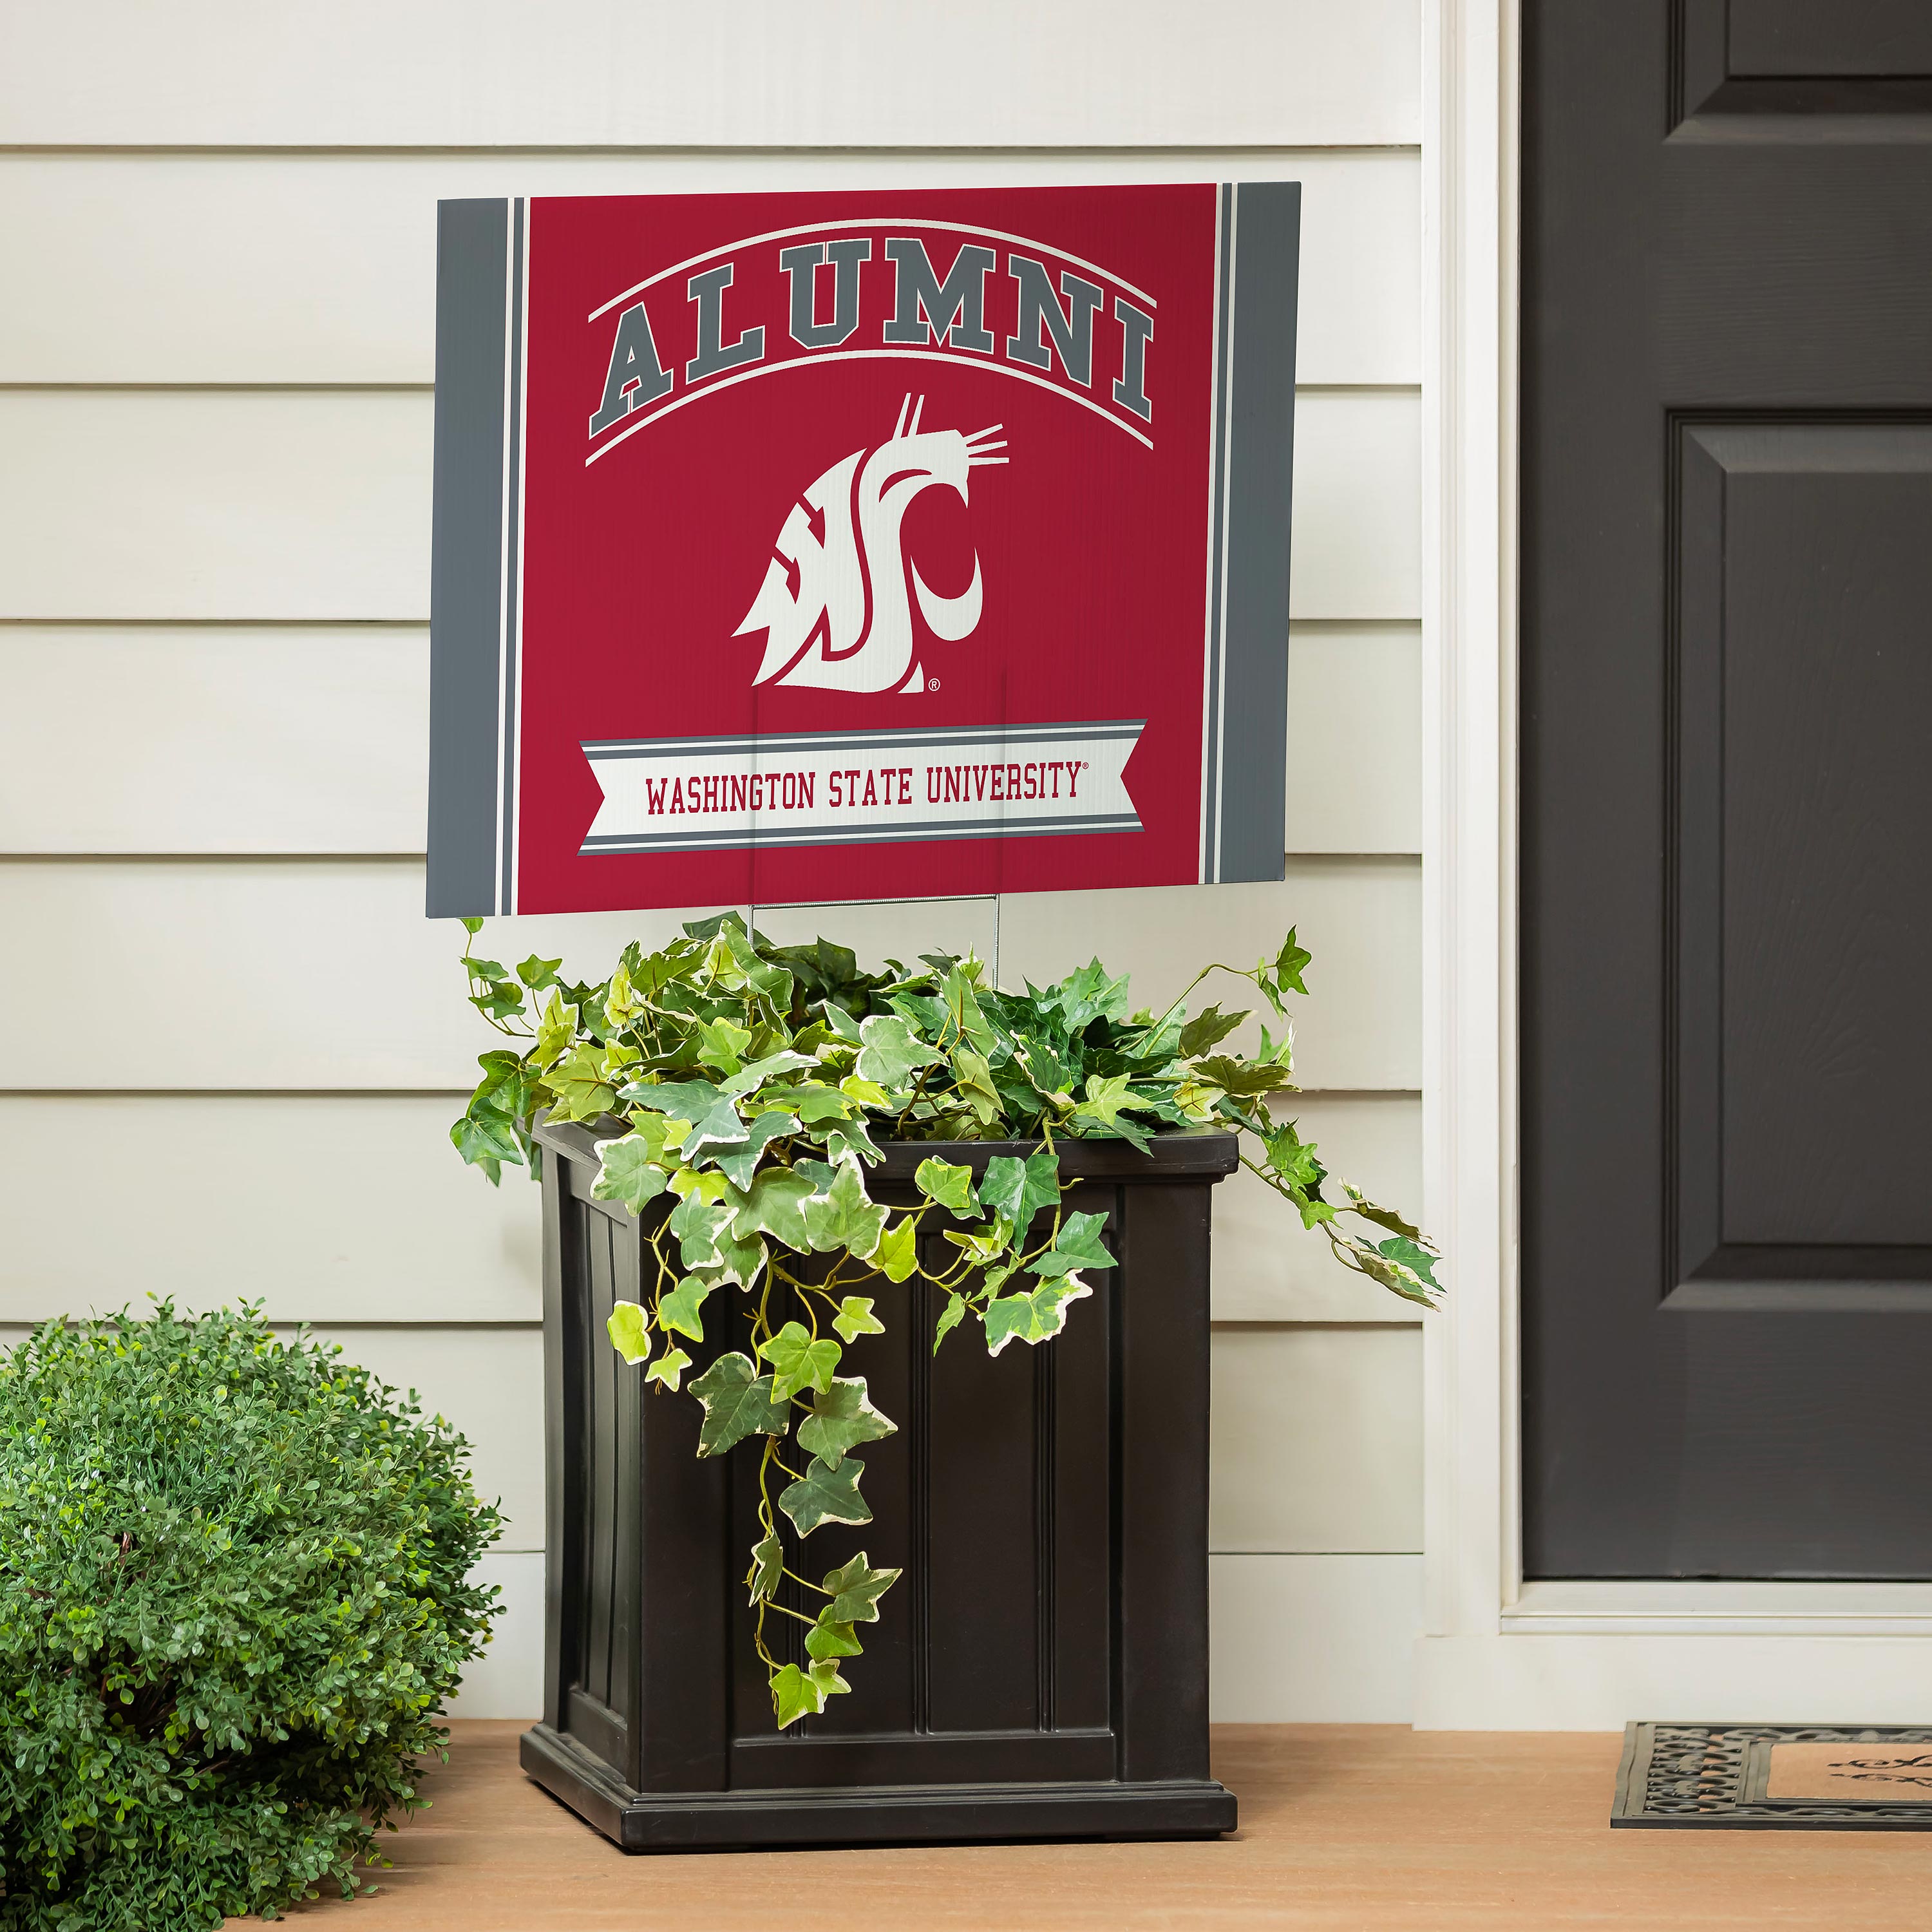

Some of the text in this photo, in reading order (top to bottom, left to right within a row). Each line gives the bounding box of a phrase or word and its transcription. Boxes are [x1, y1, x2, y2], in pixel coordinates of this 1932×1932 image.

[589, 237, 1154, 440] ALUMNI
[645, 772, 816, 815] WASHINGTON
[829, 768, 913, 808] STATE
